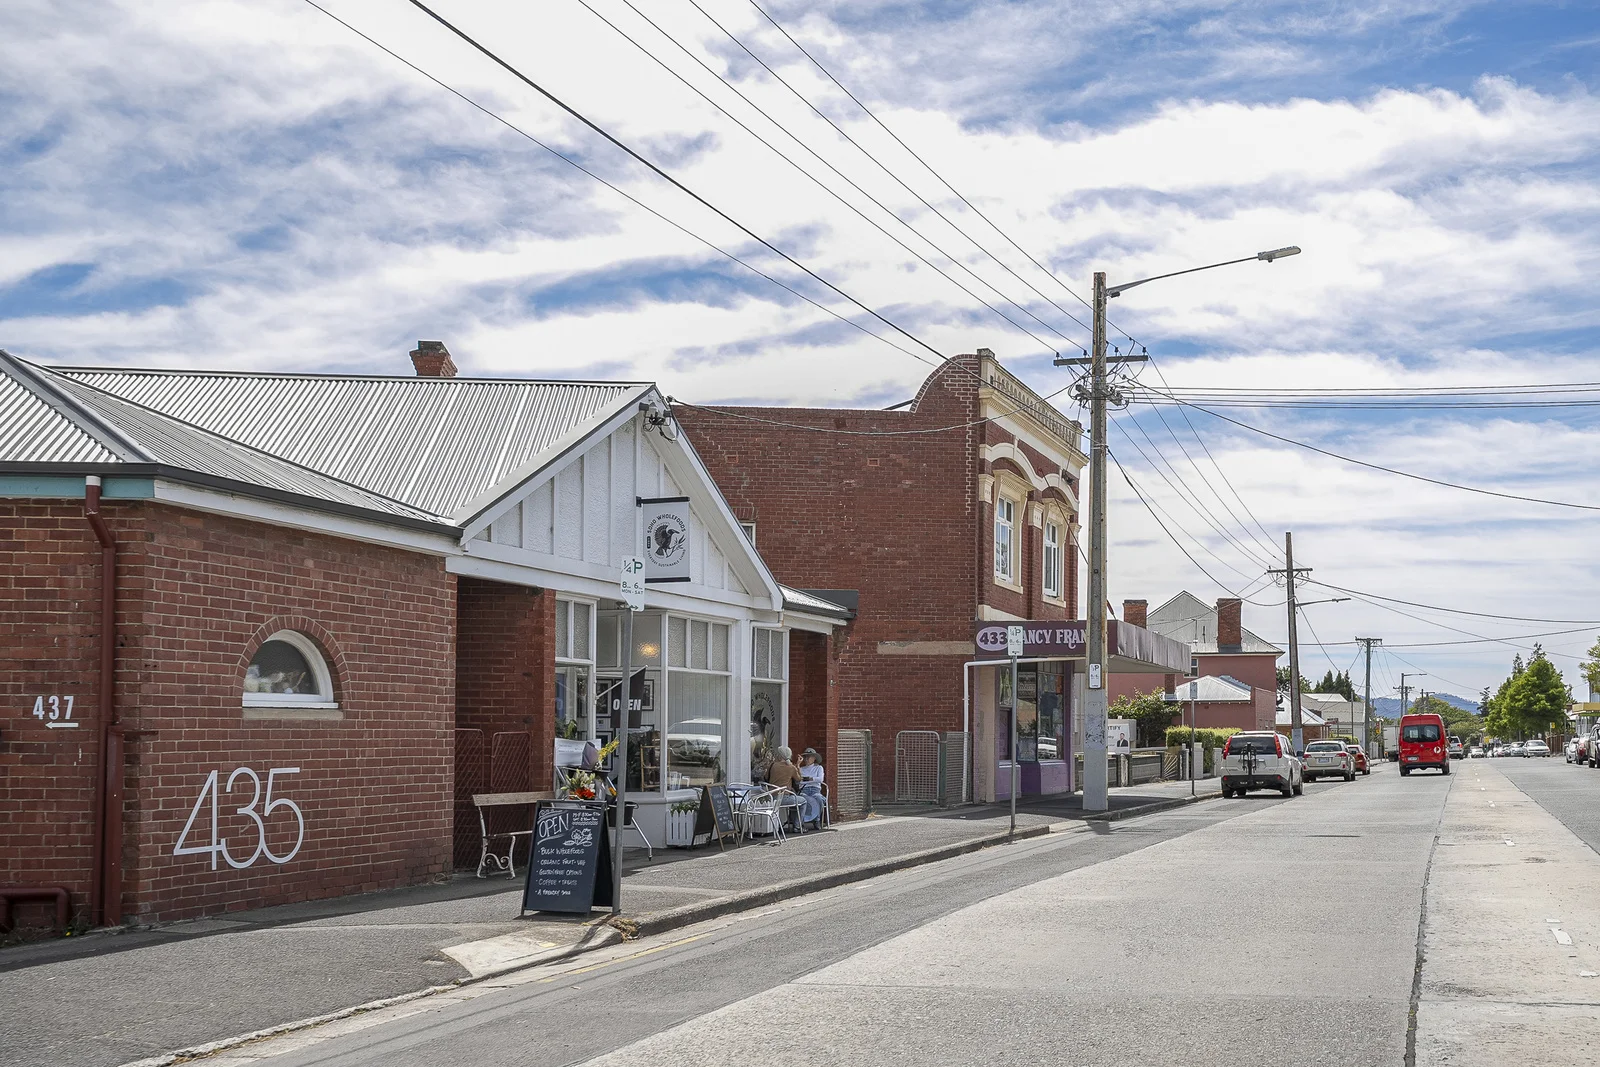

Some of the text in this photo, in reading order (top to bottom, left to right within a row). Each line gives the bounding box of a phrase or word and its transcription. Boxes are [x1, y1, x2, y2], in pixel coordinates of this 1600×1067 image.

[657, 514, 686, 532] WHOLEFOODS
[979, 631, 1008, 646] 433
[33, 695, 75, 720] 437
[613, 698, 642, 711] OEN
[173, 766, 305, 871] 435
[538, 812, 569, 838] OPEN
